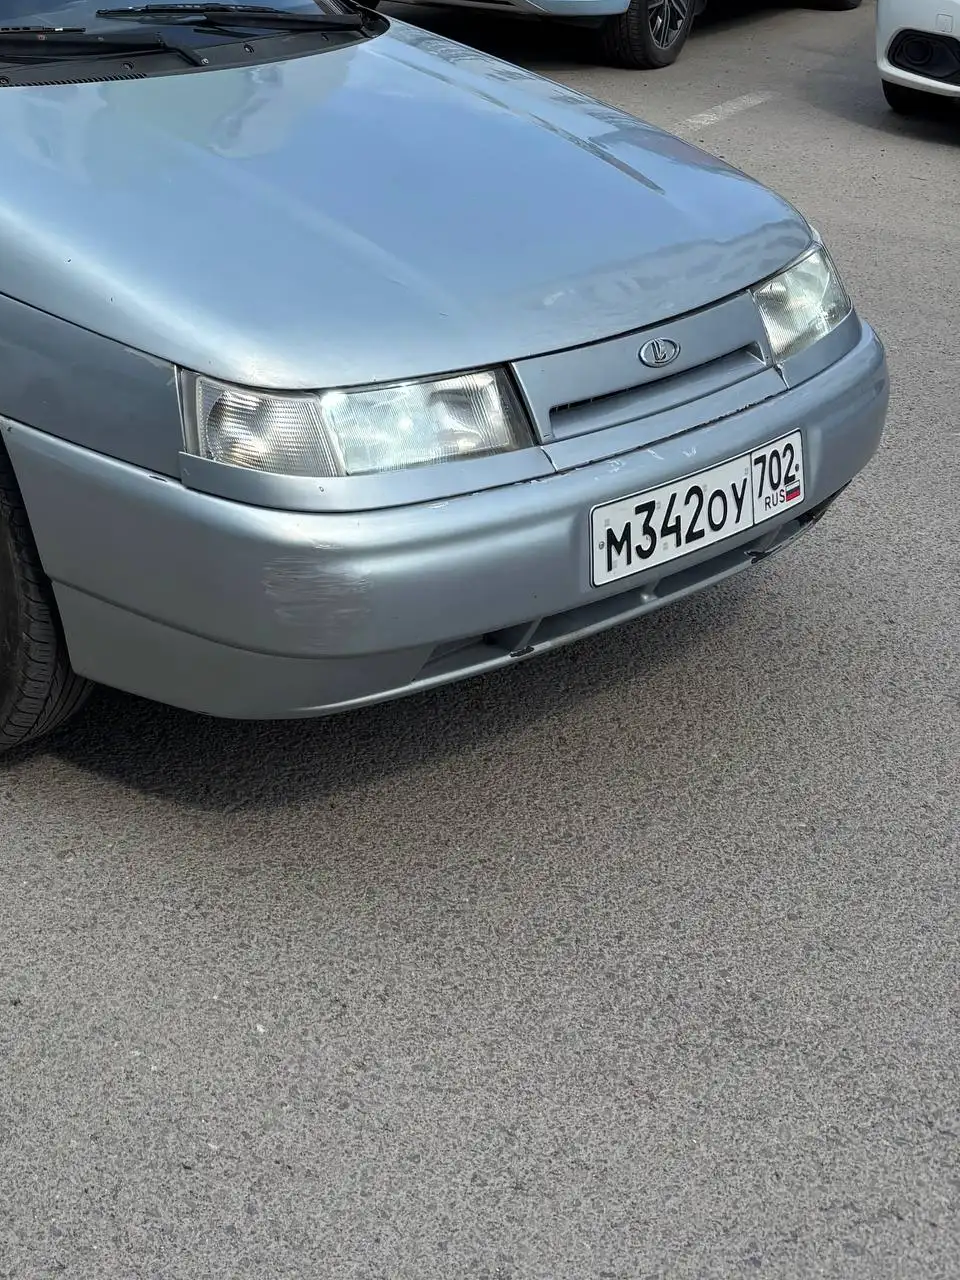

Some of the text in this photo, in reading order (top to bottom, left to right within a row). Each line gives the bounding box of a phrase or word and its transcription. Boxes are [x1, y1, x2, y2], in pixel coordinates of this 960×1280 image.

[606, 442, 796, 572] М342ОУ 702
[764, 488, 785, 511] RUS
